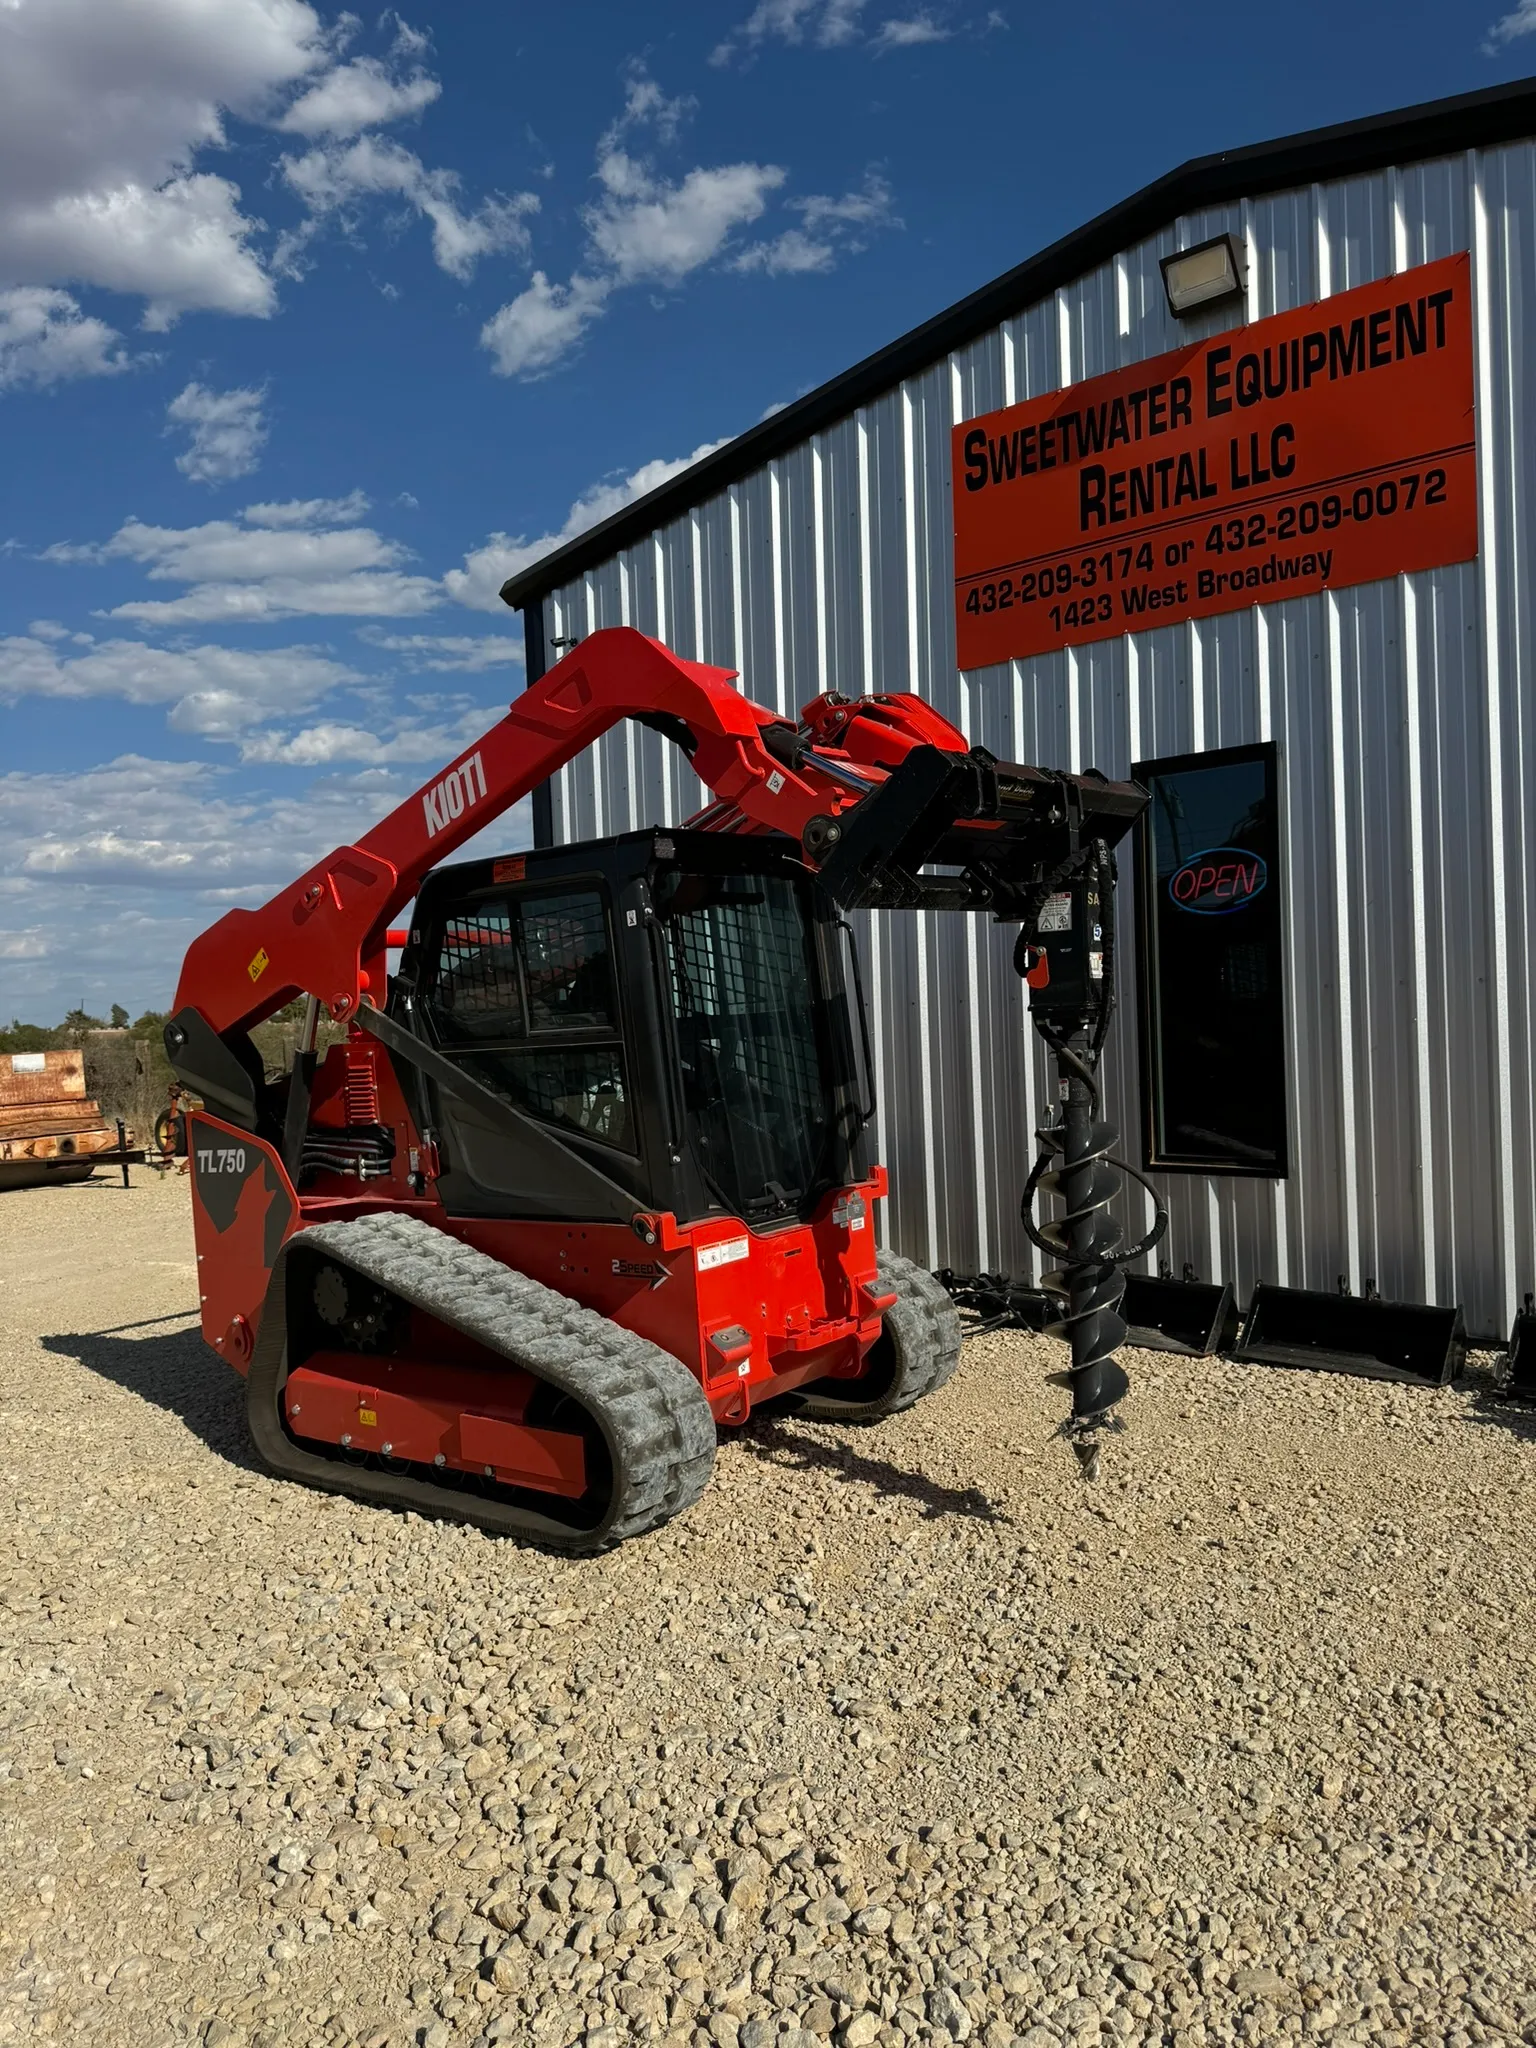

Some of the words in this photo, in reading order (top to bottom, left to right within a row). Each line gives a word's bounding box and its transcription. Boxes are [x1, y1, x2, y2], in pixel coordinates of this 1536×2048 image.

[964, 375, 1191, 492] SWEETWATER
[1206, 289, 1453, 419] EQUIPMENT
[1080, 447, 1217, 532] RENTAL
[1230, 422, 1296, 491] LLC
[965, 542, 1154, 616] 432-209-3174
[1164, 540, 1195, 567] or
[1204, 468, 1447, 555] 432-209-0072
[1049, 594, 1113, 632] 1423
[1121, 579, 1188, 617] West
[1199, 548, 1333, 599] Broadway
[422, 750, 487, 838] KIOTI
[1174, 862, 1258, 899] OPEN
[197, 1148, 246, 1173] TL750
